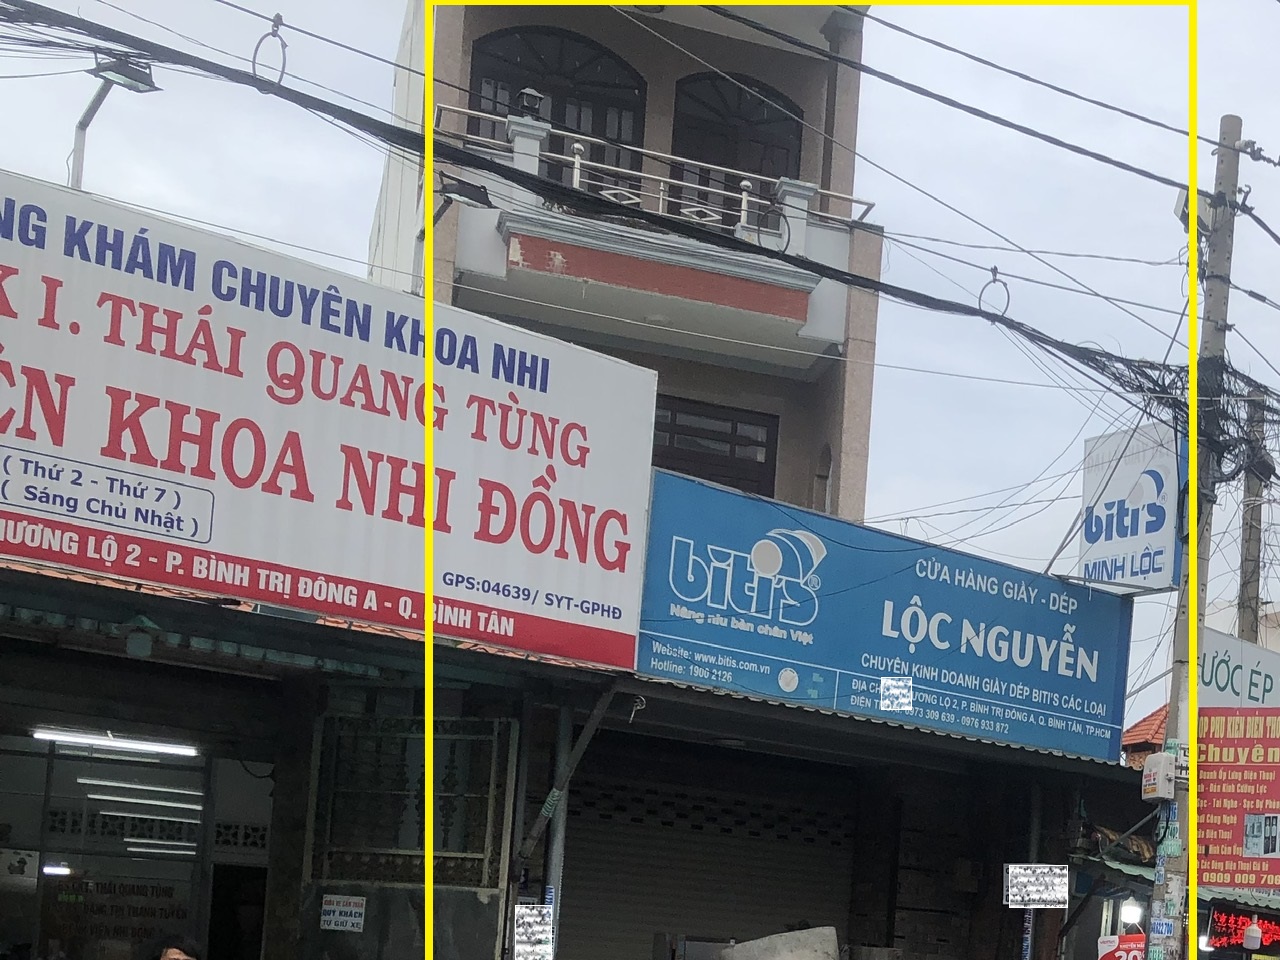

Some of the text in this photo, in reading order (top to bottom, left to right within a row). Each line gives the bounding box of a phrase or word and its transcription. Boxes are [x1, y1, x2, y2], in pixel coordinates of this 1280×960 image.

[63, 214, 197, 292] KHÁM
[211, 259, 373, 343] CHUYÊN
[383, 309, 480, 375] KHOA
[491, 341, 550, 394] NHI
[38, 275, 80, 335] I.
[96, 291, 247, 379] THÁI
[266, 340, 449, 432] QUANG
[466, 391, 591, 469] TÙNG
[19, 458, 167, 503] Thứ 2 Thứ 7
[100, 385, 315, 503] KHOA
[335, 443, 457, 534] NHI
[473, 463, 632, 573] ĐỒNG
[23, 485, 185, 534] Sáng Chủ Nhật
[87, 534, 118, 567] LỘ
[124, 544, 141, 567] 2
[165, 551, 184, 575] P.
[192, 554, 250, 590] BÌNH
[256, 568, 291, 597] TRỊ
[297, 572, 358, 607] ĐÔNG
[363, 589, 378, 611] A
[398, 596, 417, 619] Q.
[477, 609, 515, 638] TÂN
[915, 557, 1078, 615] CỬA HÀNG GIÀY DÉP
[1084, 546, 1164, 581] MINH LỘC
[442, 571, 623, 620] GPS:04639/ SYT-GPHĐ
[652, 640, 771, 675] Website: www.bitis.com.vn
[881, 595, 1099, 683] LỘC NGUYỄN
[650, 658, 733, 683] Hotline: 1900 2126
[861, 653, 909, 677] CHUYÊN
[941, 668, 980, 690] DOANH
[982, 677, 1008, 697] GIÀY
[1009, 682, 1030, 701] DÉP
[1032, 688, 1059, 707] BITI'S
[1061, 694, 1082, 712] CÁC
[1084, 699, 1107, 718] LOẠI
[1201, 650, 1243, 697] ƯỚC
[1248, 660, 1274, 704] ÉP
[850, 695, 872, 710] ĐIỆN
[925, 708, 939, 720] 309
[941, 711, 955, 724] 639
[961, 716, 979, 729] 0976
[981, 719, 994, 731] 933
[995, 722, 1009, 734] 872
[851, 679, 867, 693] ĐỊA
[939, 696, 951, 709] LỘ
[970, 702, 989, 716] BÌNH
[991, 706, 1004, 720] TRỊ
[1005, 708, 1028, 722] ĐÔNG
[1048, 716, 1066, 731] BÌNH
[1085, 724, 1112, 740] TP.HCM
[1197, 744, 1280, 766] Chuyên
[1203, 872, 1231, 884] 0909
[1234, 873, 1256, 885] 009
